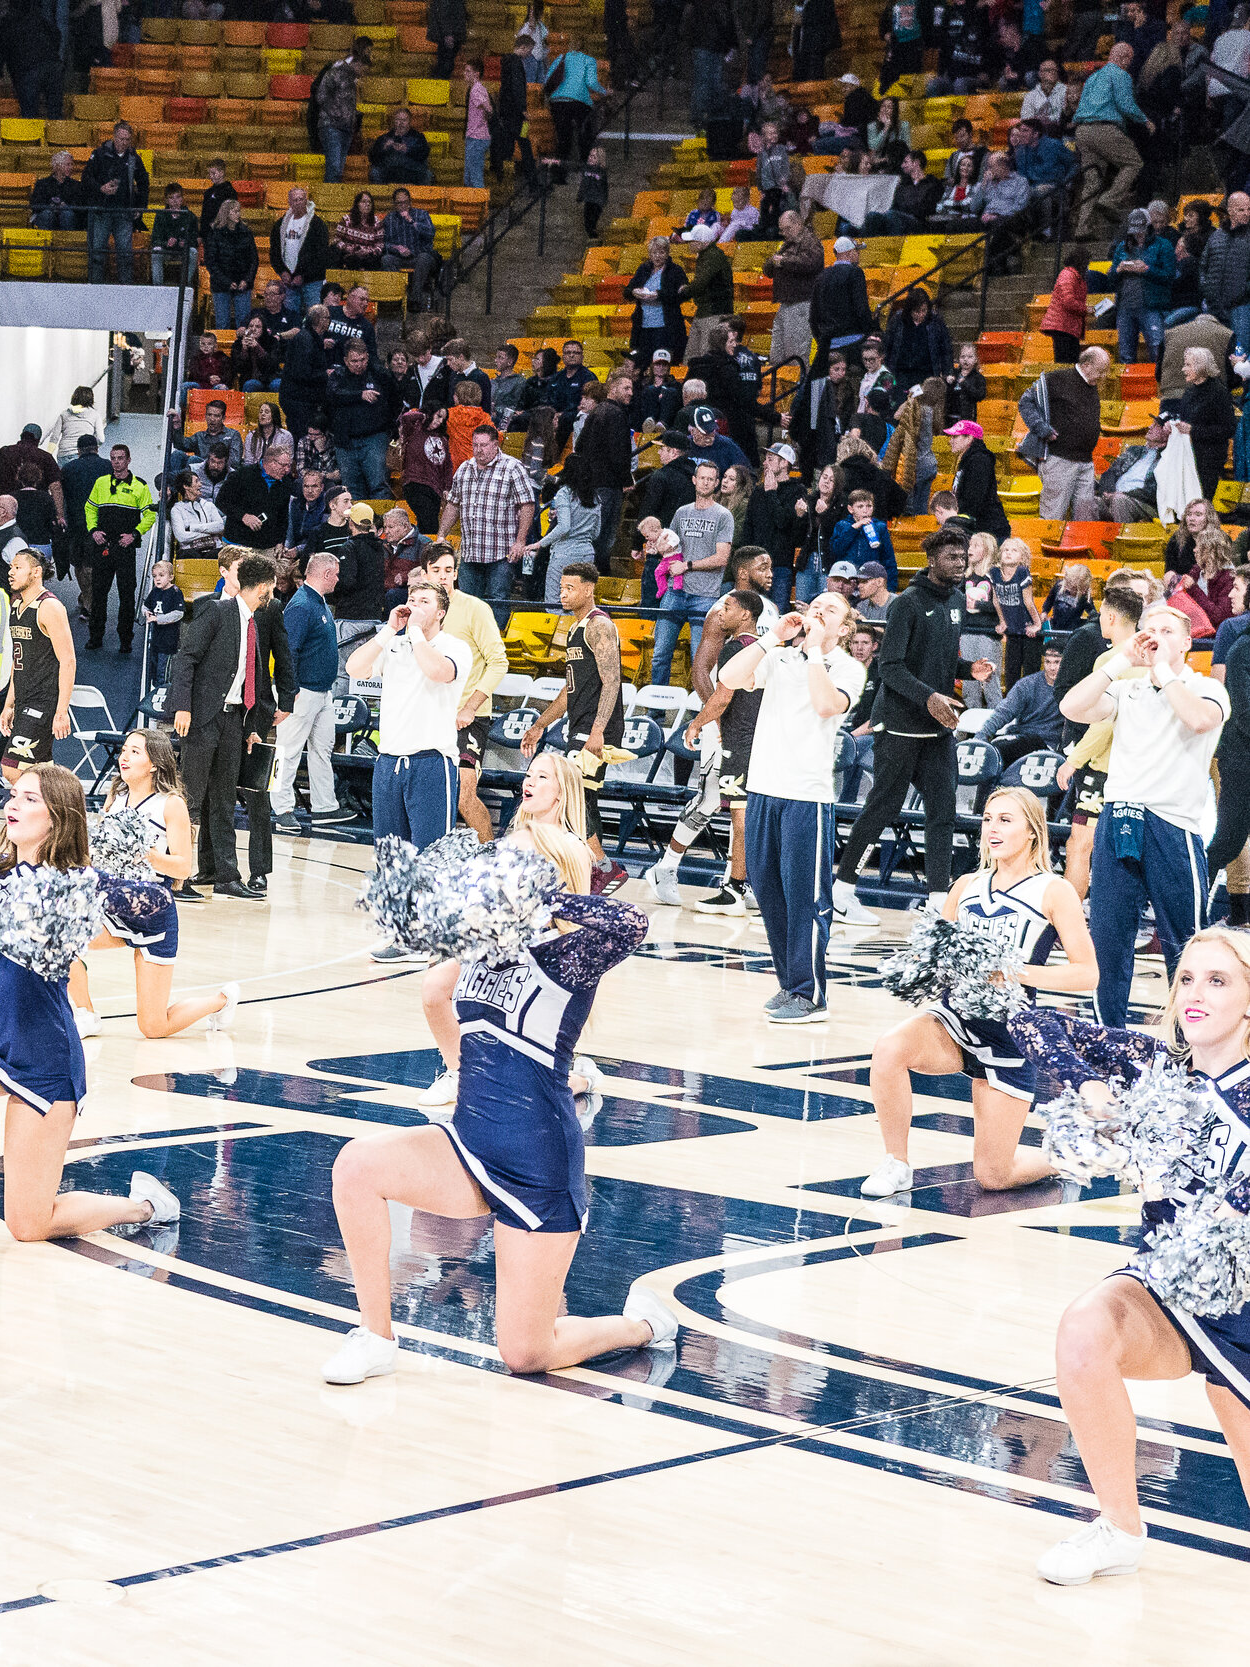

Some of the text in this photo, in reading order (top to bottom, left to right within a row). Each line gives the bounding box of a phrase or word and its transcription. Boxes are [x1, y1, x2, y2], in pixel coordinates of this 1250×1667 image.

[329, 322, 363, 339] AGGIES
[695, 519, 717, 533] STATE
[356, 680, 382, 689] GATORA
[453, 960, 530, 1014] AGGIES
